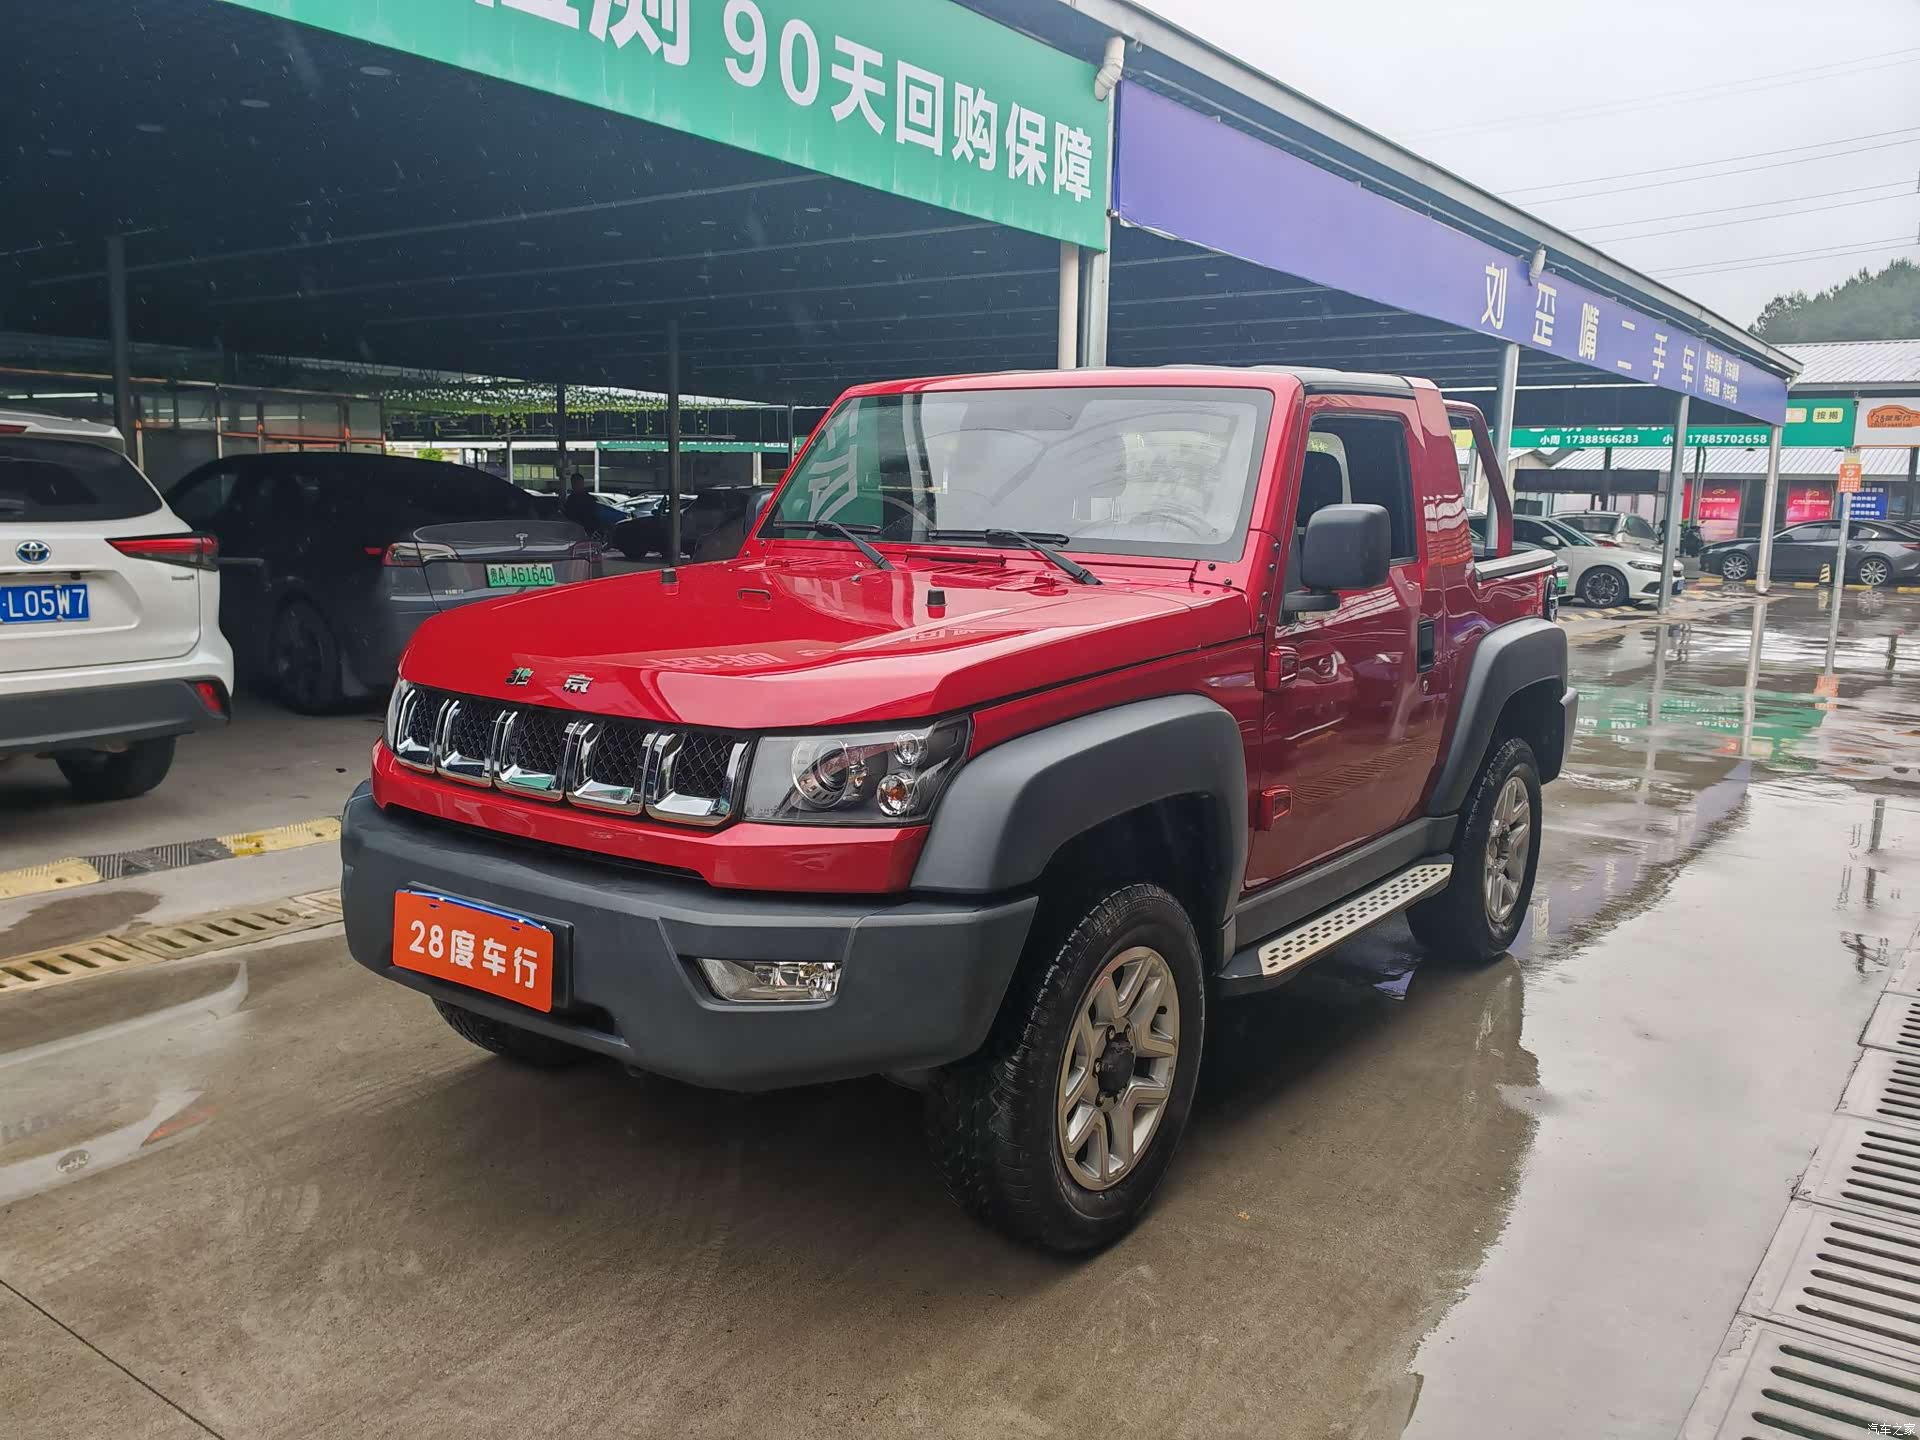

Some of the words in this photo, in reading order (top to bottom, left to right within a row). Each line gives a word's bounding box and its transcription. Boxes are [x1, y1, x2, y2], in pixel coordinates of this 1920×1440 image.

[723, 0, 1092, 202] 90天回购保障
[1540, 434, 1560, 445] 小周
[1566, 434, 1639, 444] 17388566283
[1688, 434, 1767, 444] 17885702658
[8, 588, 86, 618] L05W7
[505, 666, 594, 694] 北京
[409, 920, 538, 989] 28度车行
